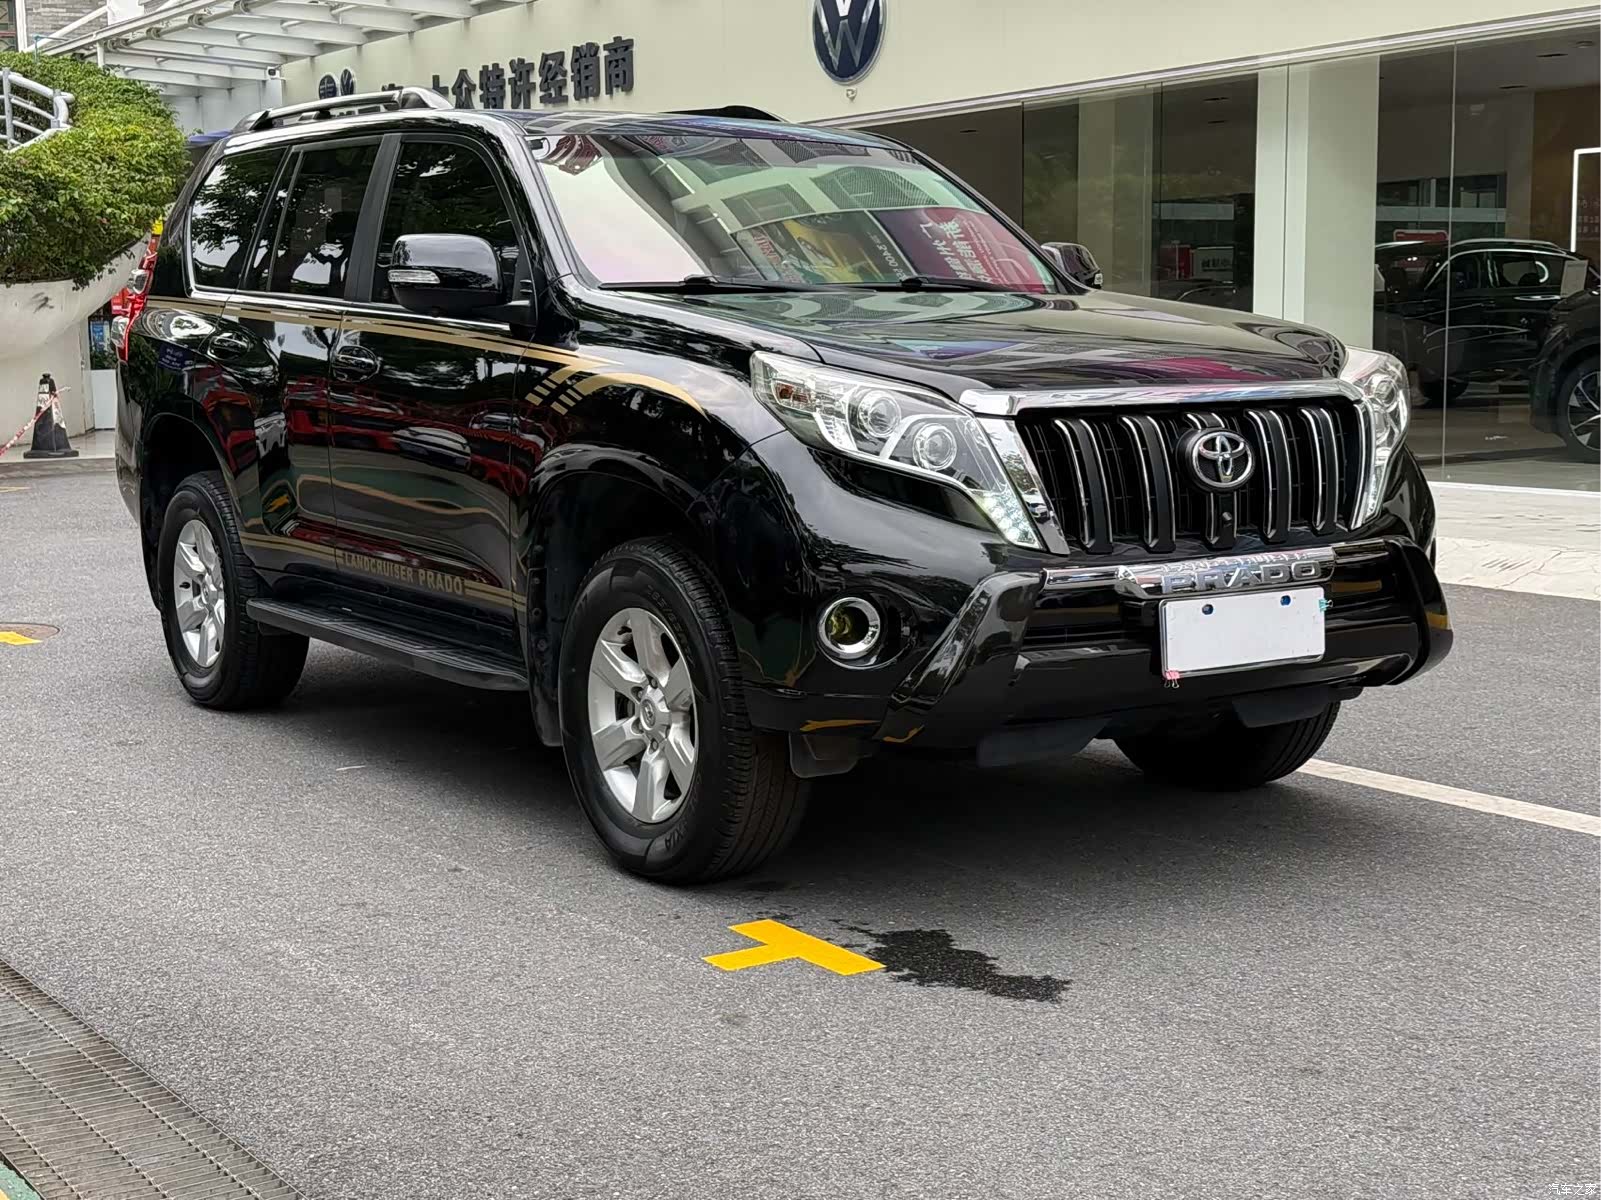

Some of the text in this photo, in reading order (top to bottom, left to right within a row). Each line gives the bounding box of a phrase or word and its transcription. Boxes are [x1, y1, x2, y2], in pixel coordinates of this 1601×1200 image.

[343, 551, 465, 595] LANDCRUISER PRADO
[1160, 560, 1321, 594] PRADO
